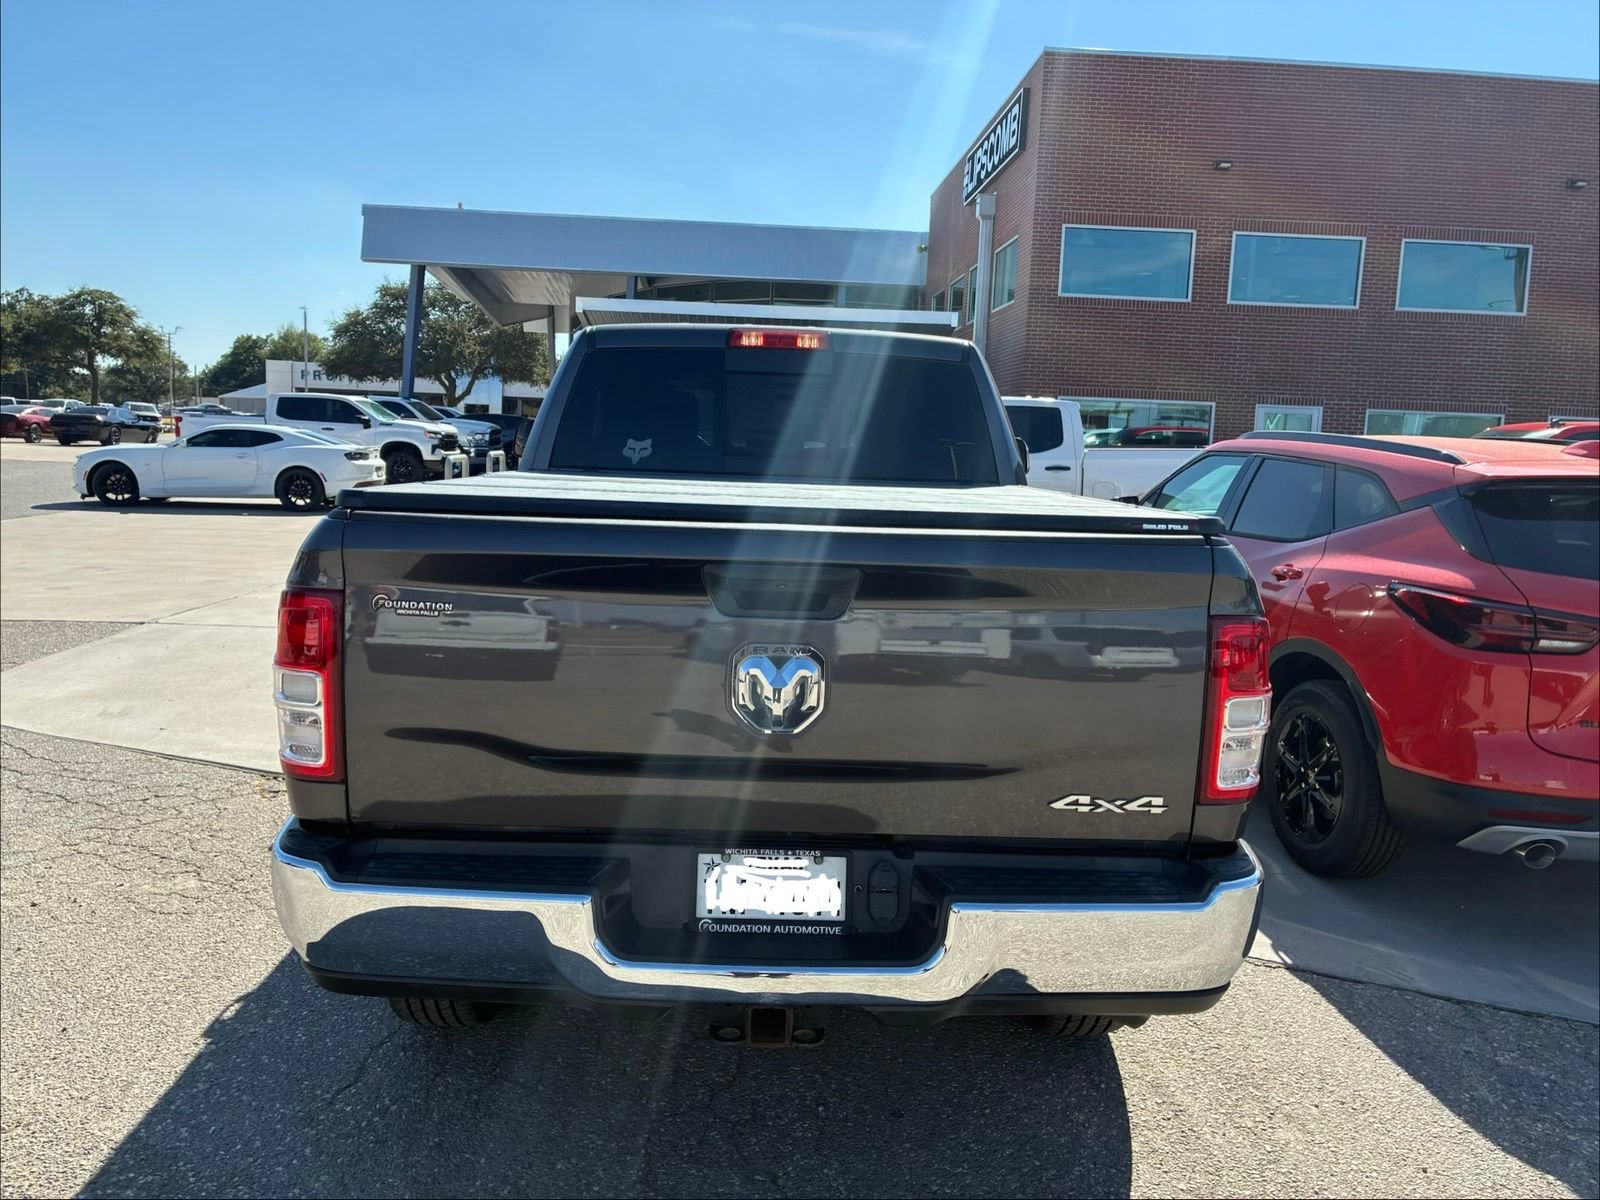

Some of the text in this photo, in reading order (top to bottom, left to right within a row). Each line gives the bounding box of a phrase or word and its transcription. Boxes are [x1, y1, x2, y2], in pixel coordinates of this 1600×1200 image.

[966, 103, 1020, 194] LIPSCOMB
[372, 594, 453, 611] FOUNDATION
[752, 645, 809, 656] RAM
[725, 848, 821, 857] WICHITA FALLS TEXAS
[698, 918, 843, 935] FOUNDATION AUTOMOTIVE
